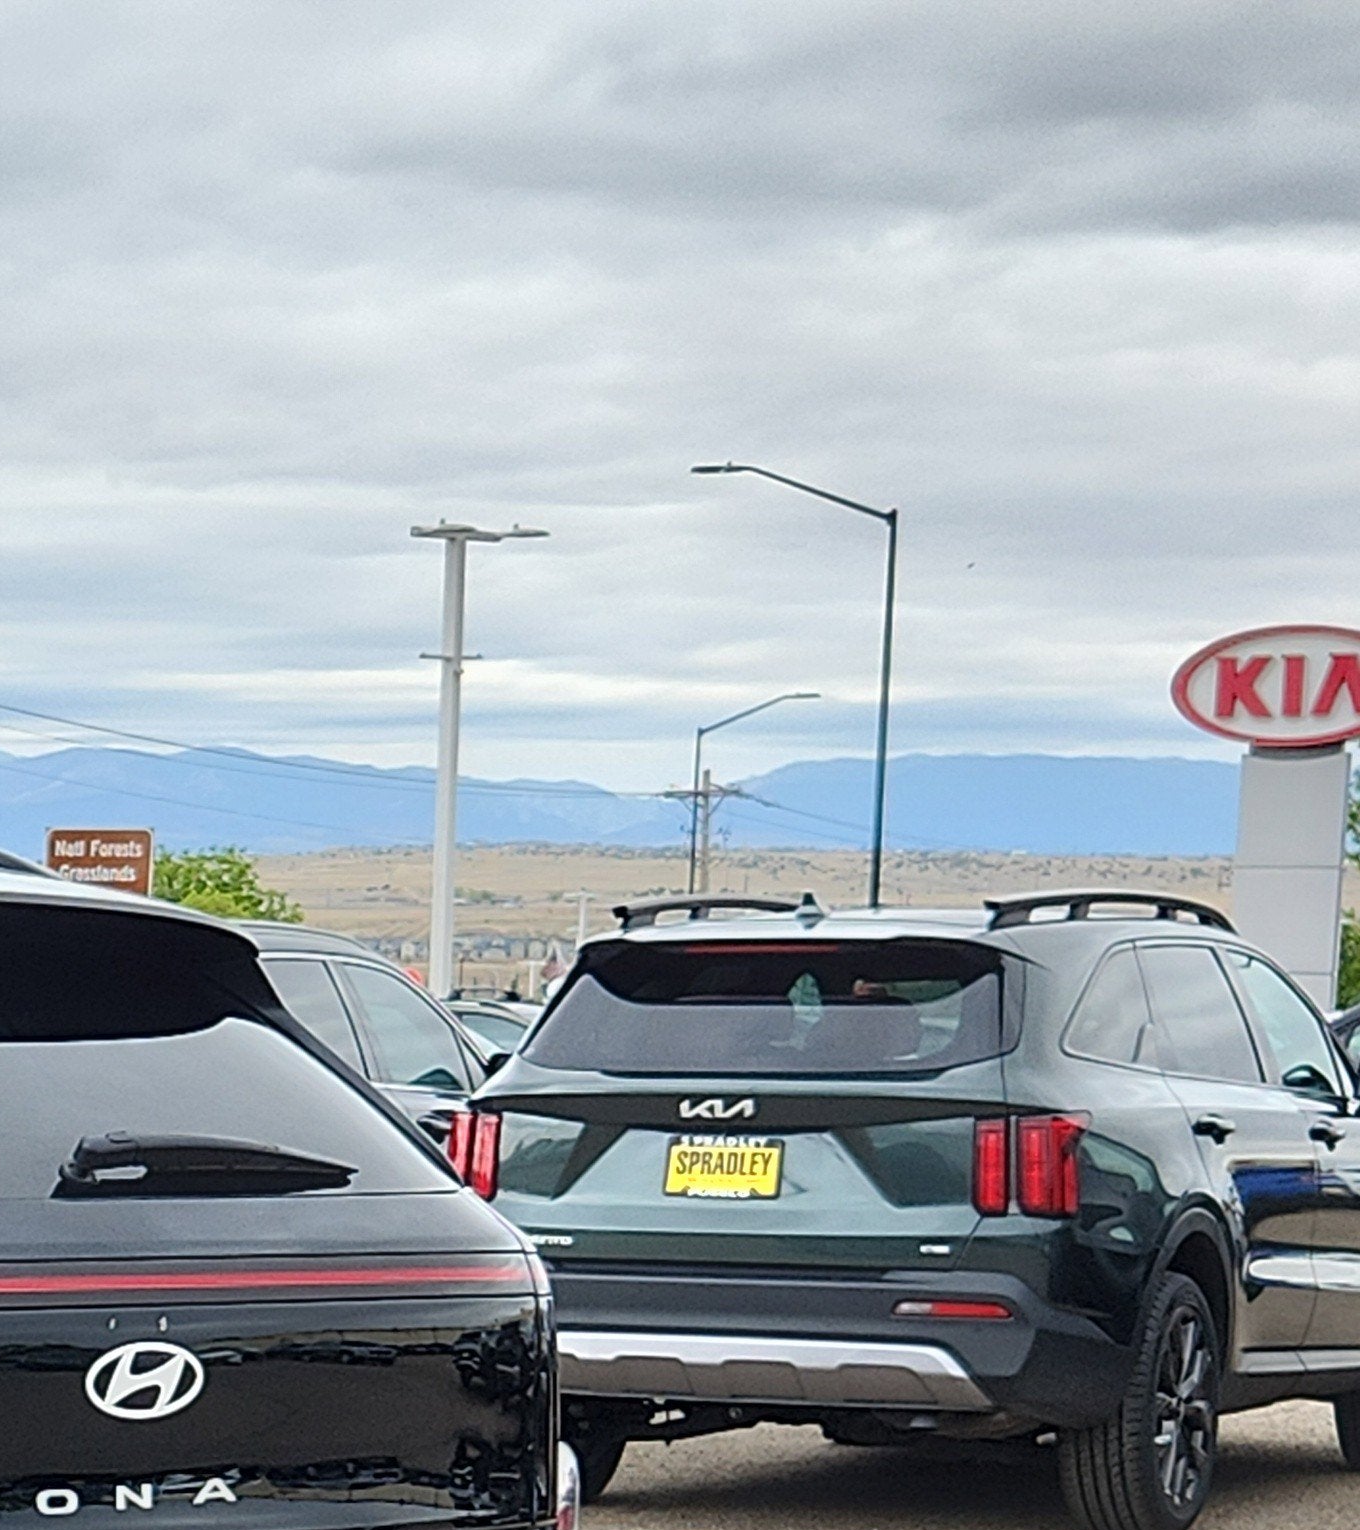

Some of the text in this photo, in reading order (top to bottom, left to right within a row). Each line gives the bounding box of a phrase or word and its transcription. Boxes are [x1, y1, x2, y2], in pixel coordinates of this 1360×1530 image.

[1213, 653, 1360, 719] KIA
[90, 840, 143, 858] Forests
[679, 1099, 755, 1118] KIA
[675, 1150, 773, 1176] SPRADLEY
